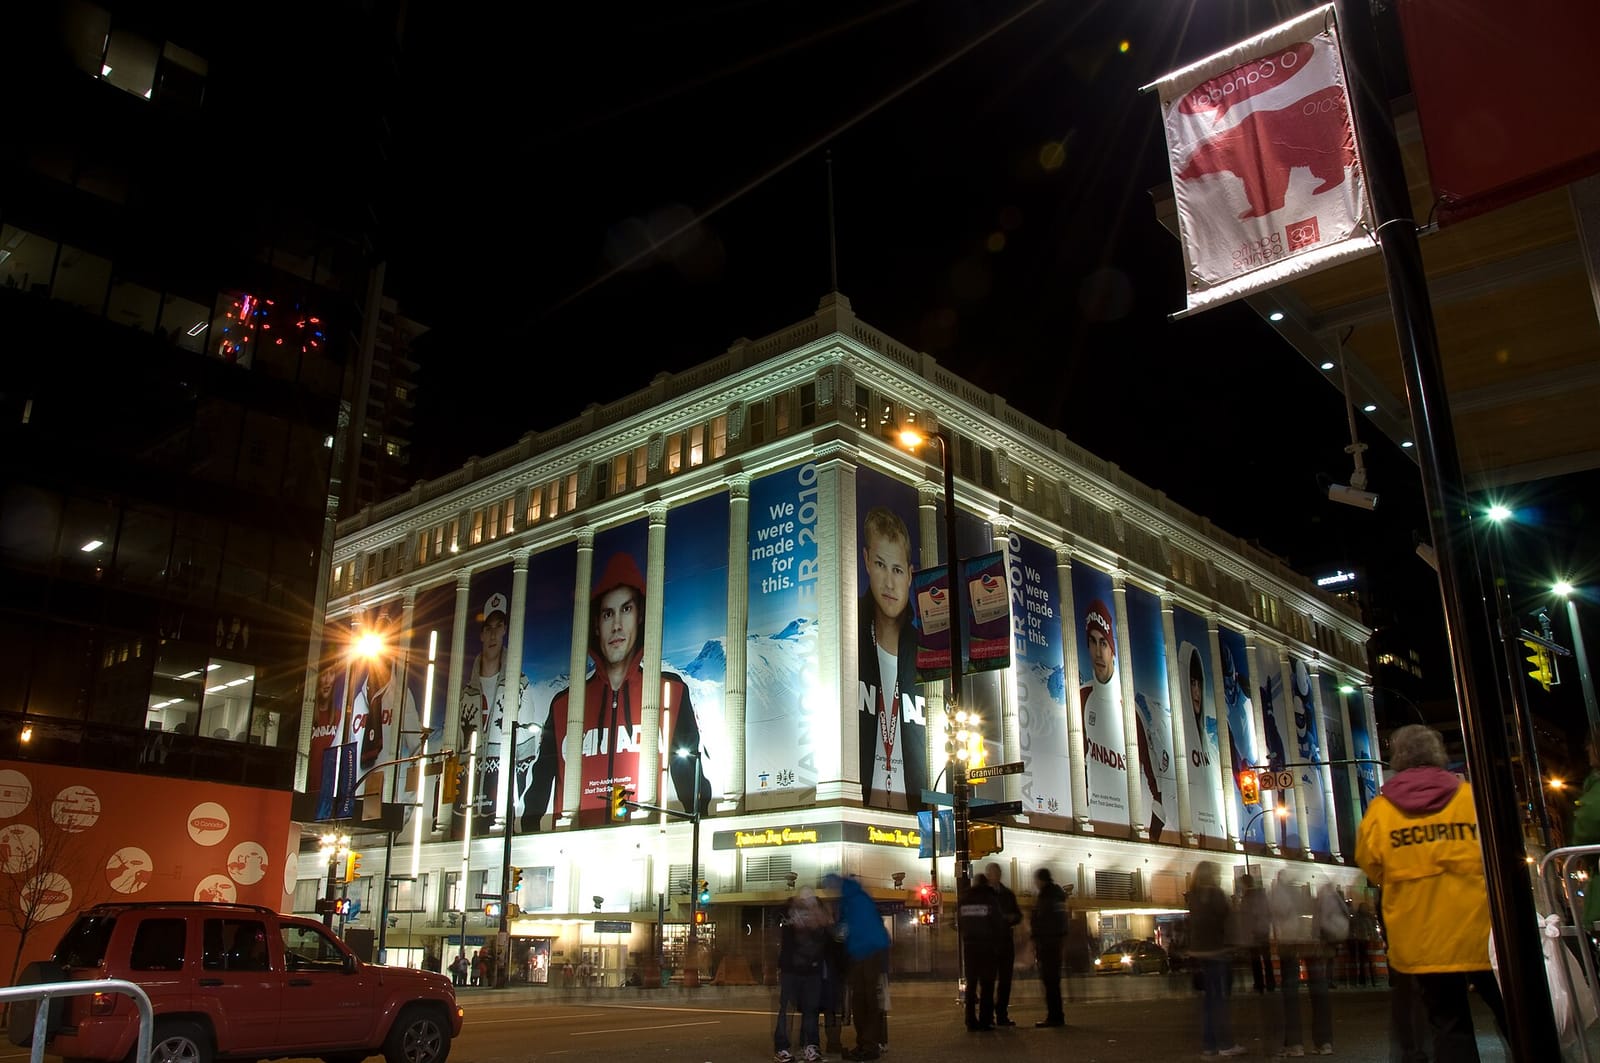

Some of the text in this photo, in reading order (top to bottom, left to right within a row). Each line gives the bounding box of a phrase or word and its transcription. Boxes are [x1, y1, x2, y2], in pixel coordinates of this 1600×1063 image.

[769, 502, 795, 521] We
[798, 463, 818, 547] 2010
[757, 521, 795, 542] were
[752, 538, 795, 561] made
[771, 556, 795, 574] for
[1008, 532, 1024, 607] 2010
[1024, 565, 1041, 584] We
[761, 574, 795, 594] this.
[1025, 583, 1049, 602] were
[1026, 599, 1053, 618] made
[1027, 613, 1042, 629] for
[1028, 628, 1049, 647] this.
[971, 767, 1004, 778] Granville
[1389, 822, 1477, 849] SECURITY
